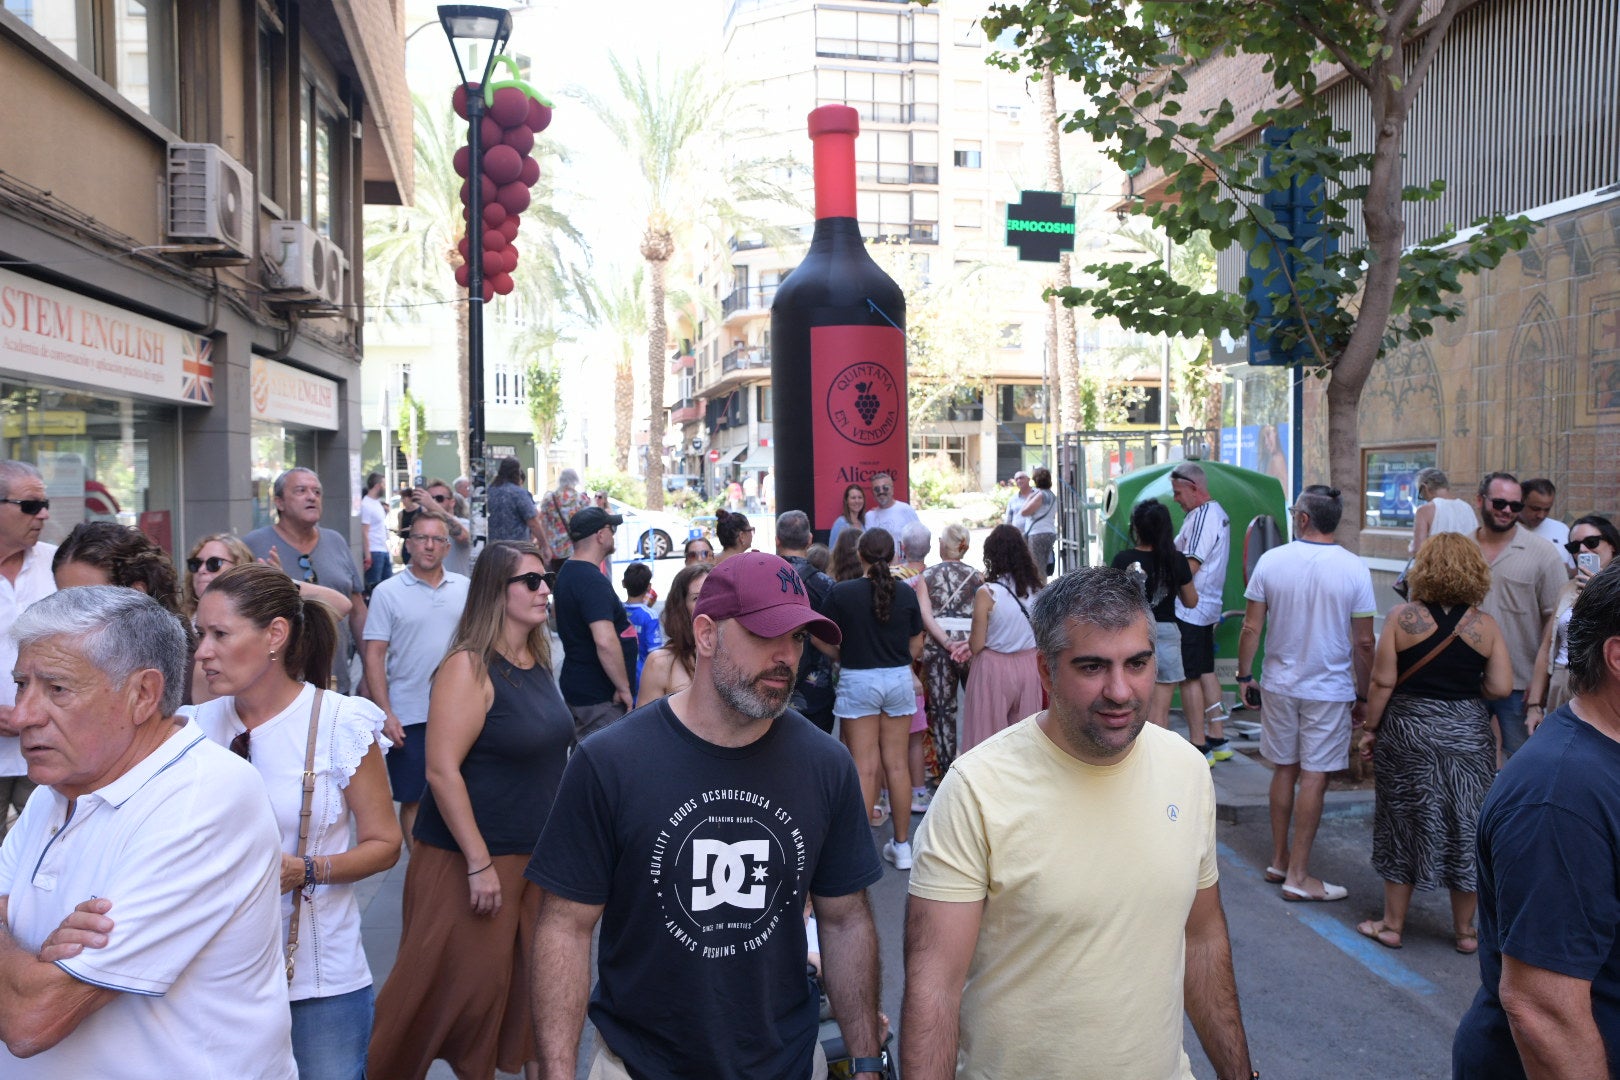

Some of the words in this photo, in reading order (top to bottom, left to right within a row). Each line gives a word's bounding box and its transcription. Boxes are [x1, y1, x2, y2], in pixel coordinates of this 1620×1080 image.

[1, 285, 74, 343] STEM
[80, 309, 165, 366] ENGLISH
[837, 365, 893, 392] QUINTANA
[834, 409, 849, 428] EN
[852, 410, 895, 441] VENDIMIA
[834, 466, 898, 483] Alicate
[650, 829, 671, 876] QUALITY
[669, 798, 698, 827] GOODS
[701, 789, 771, 810] DCSHOECOUSA
[773, 807, 793, 825] EST
[790, 827, 806, 872] MCMXCIV
[664, 919, 698, 952] ALWAYS
[702, 944, 736, 959] PUSHING
[743, 915, 780, 952] FORWARD
[715, 922, 725, 930] THE
